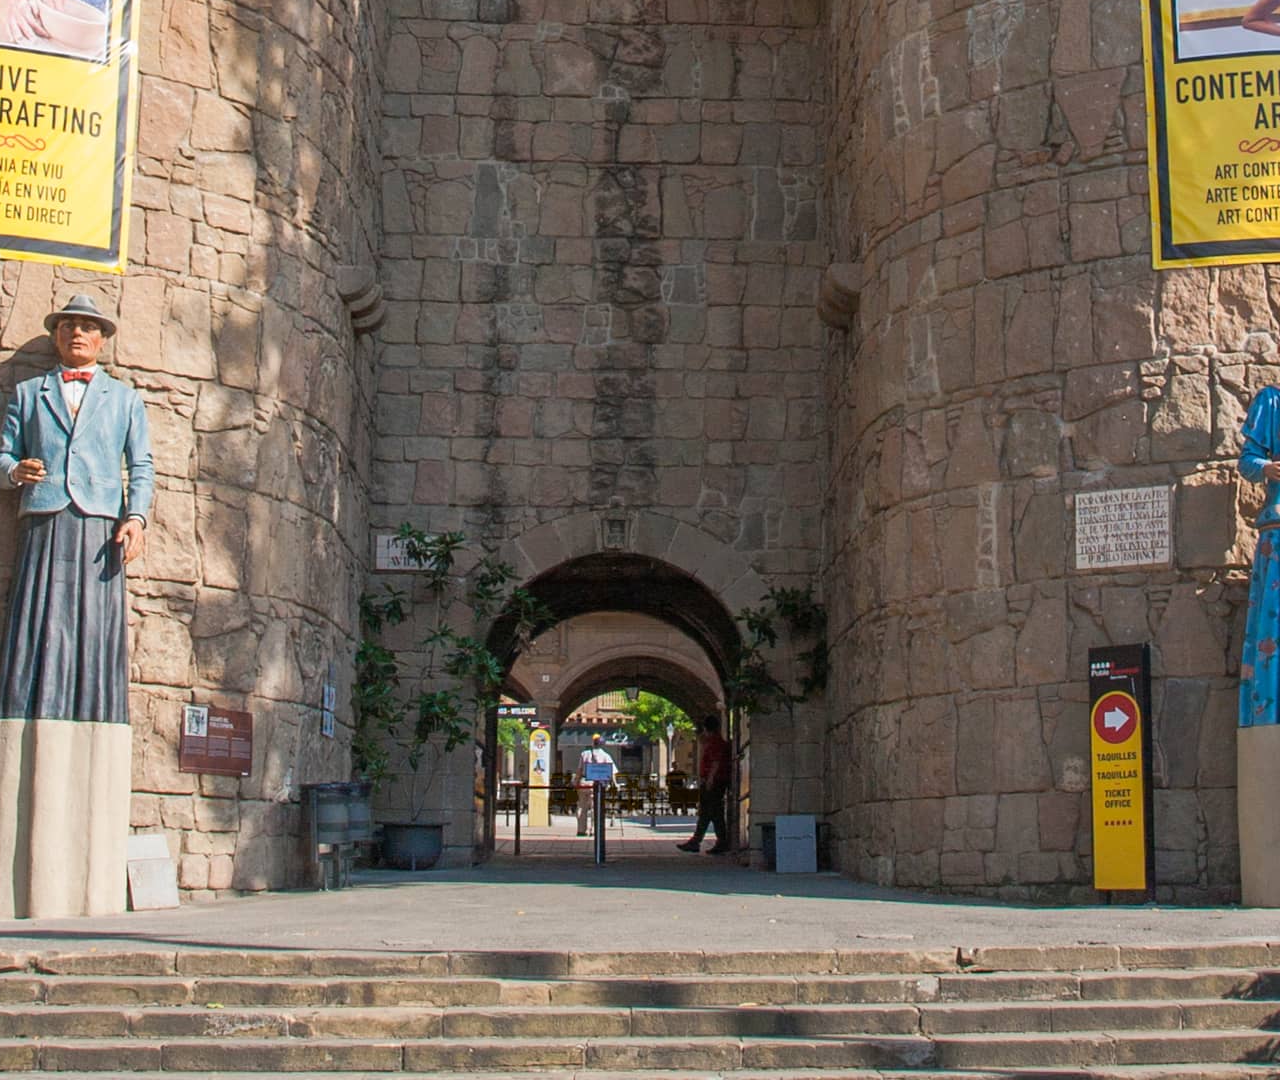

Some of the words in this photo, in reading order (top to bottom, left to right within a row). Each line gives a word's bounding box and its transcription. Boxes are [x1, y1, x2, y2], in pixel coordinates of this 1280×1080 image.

[21, 159, 37, 176] EN
[42, 163, 64, 180] VIU
[1214, 163, 1238, 180] ART
[15, 182, 32, 198] EN
[36, 185, 66, 203] VIVO
[1205, 186, 1238, 204] ARTE
[5, 202, 21, 220] EN
[26, 204, 72, 226] DIRECT
[1217, 208, 1241, 225] ART
[1096, 752, 1137, 762] TAQUILLES
[1096, 770, 1138, 780] TAQUILLAS
[1104, 789, 1131, 798] TICKET
[1104, 799, 1132, 808] OFFICE
